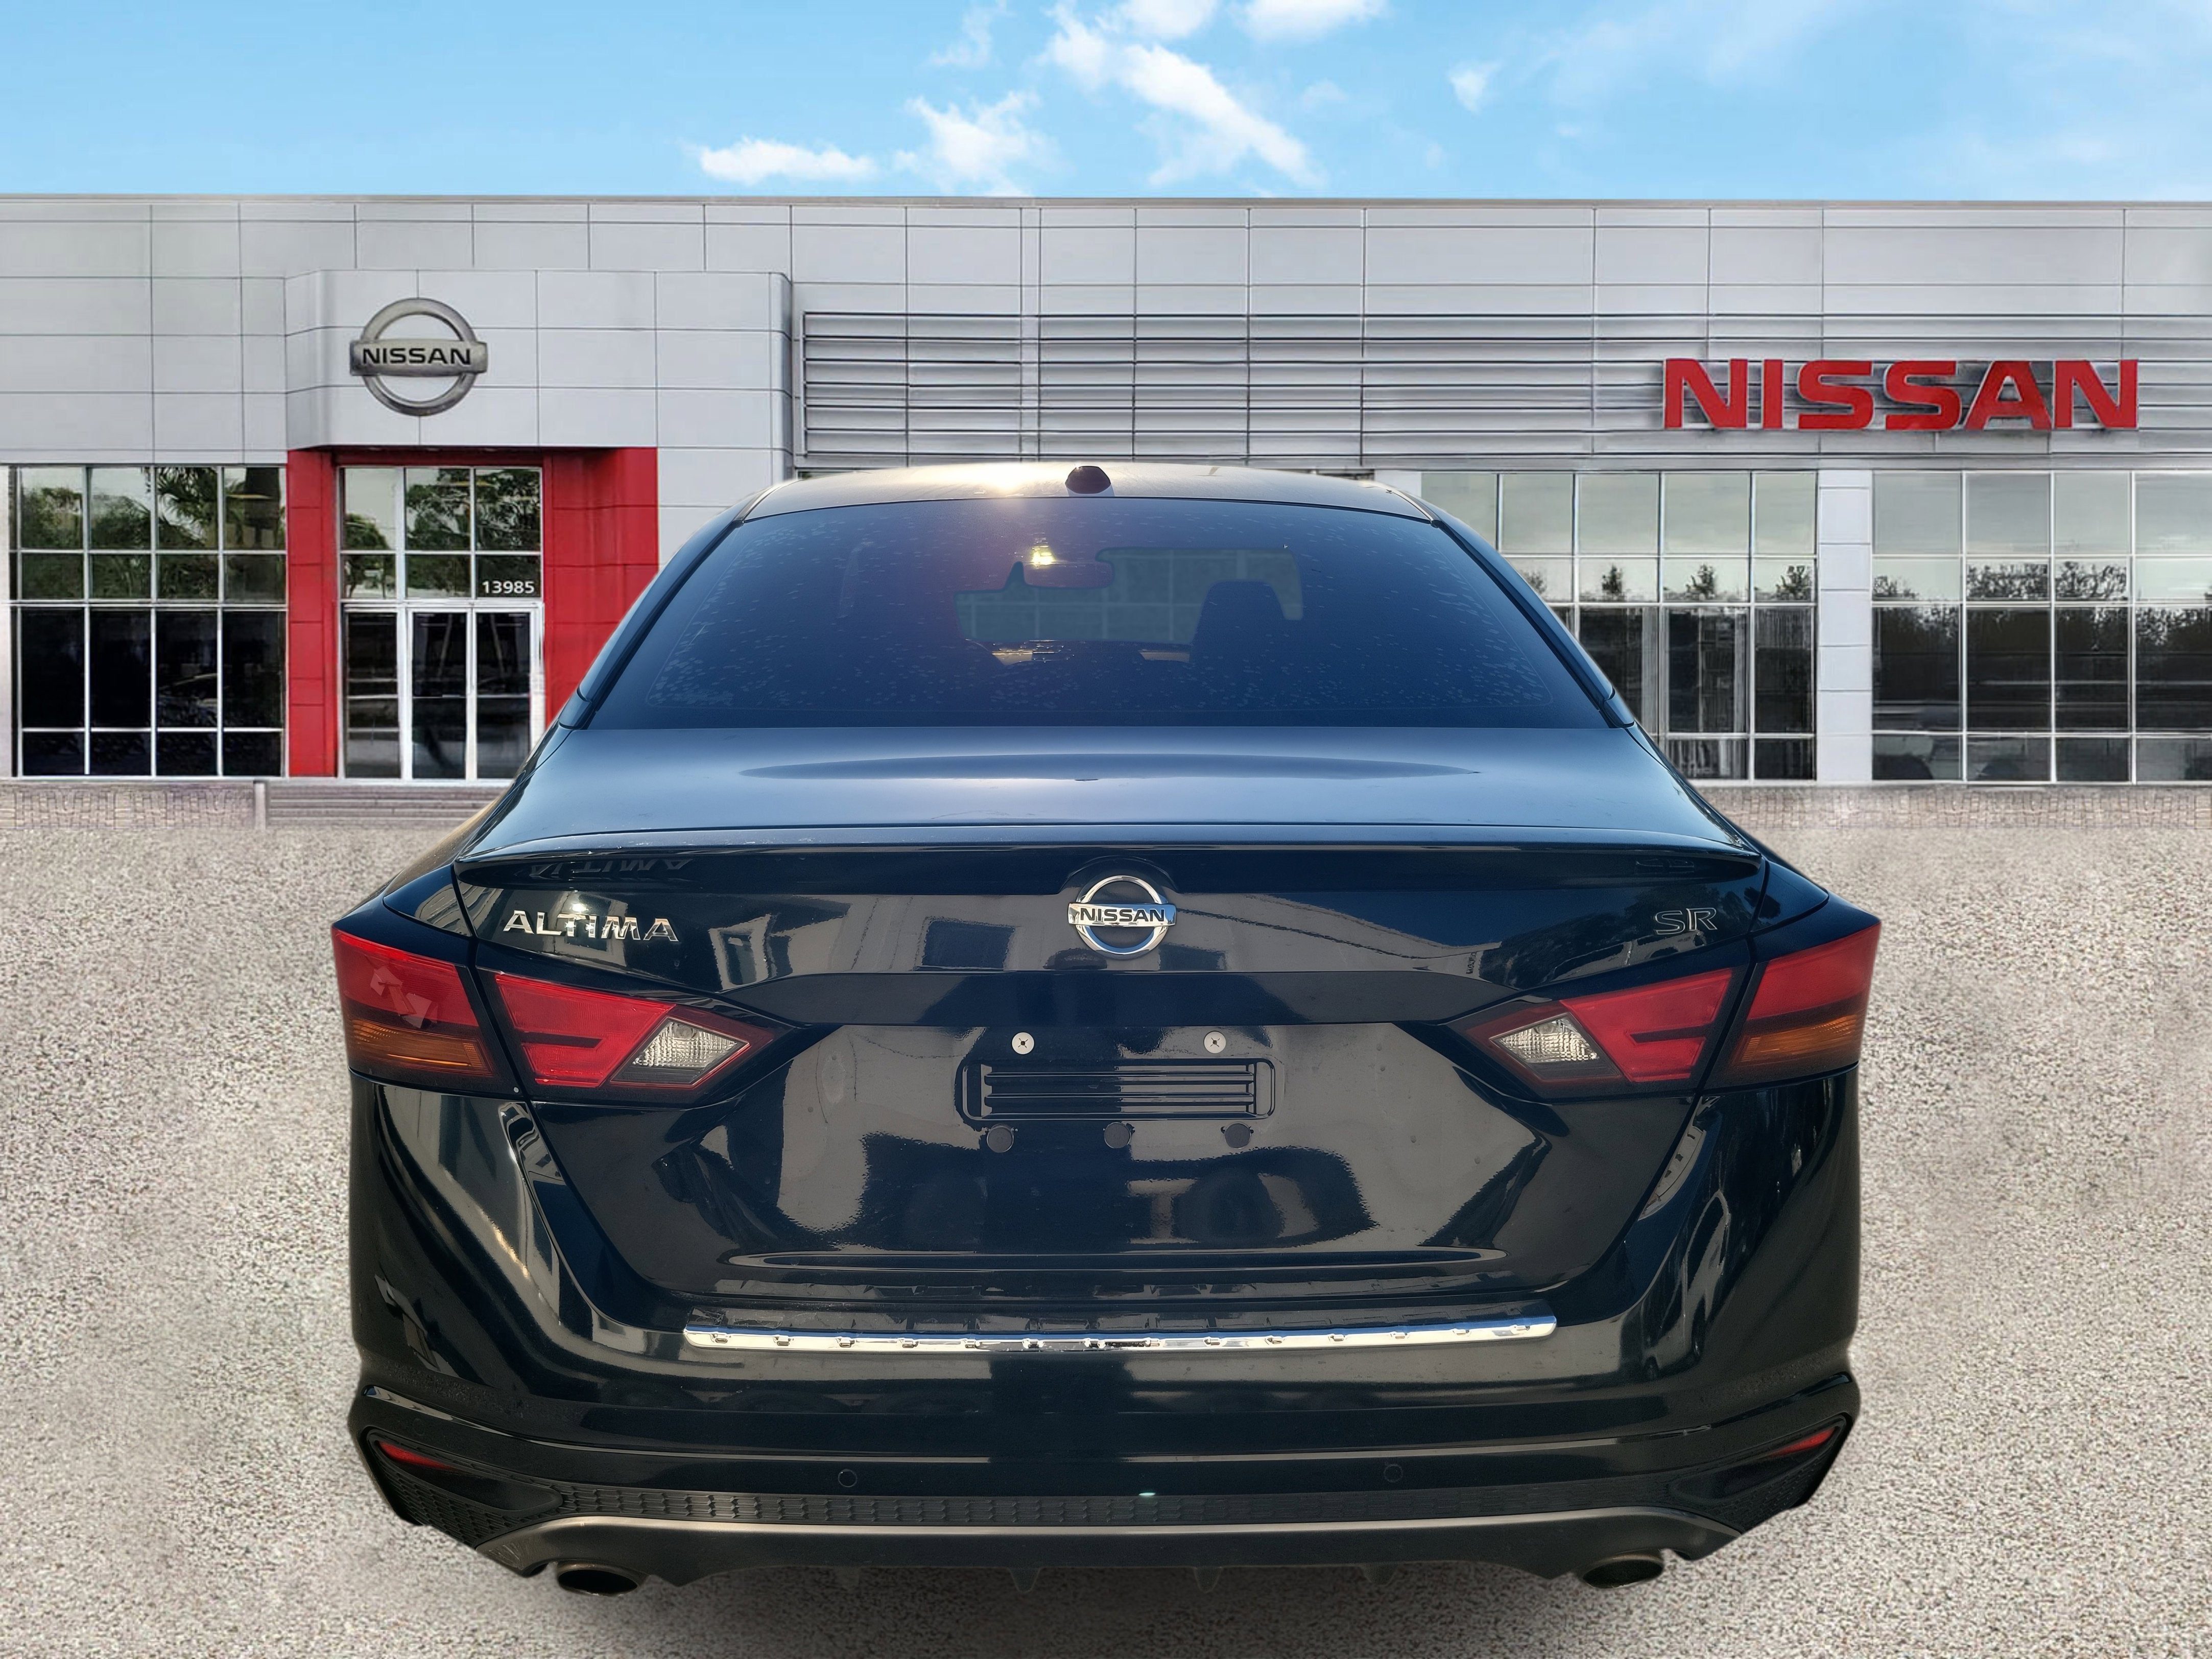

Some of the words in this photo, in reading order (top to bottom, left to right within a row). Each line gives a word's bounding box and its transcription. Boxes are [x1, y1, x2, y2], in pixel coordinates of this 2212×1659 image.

[362, 347, 472, 364] NISSAN
[1664, 358, 2138, 429] NISSAN
[482, 581, 535, 595] 13985
[503, 910, 680, 942] ALTIMA
[1080, 908, 1165, 922] NISSAN
[1654, 907, 1718, 935] SR
